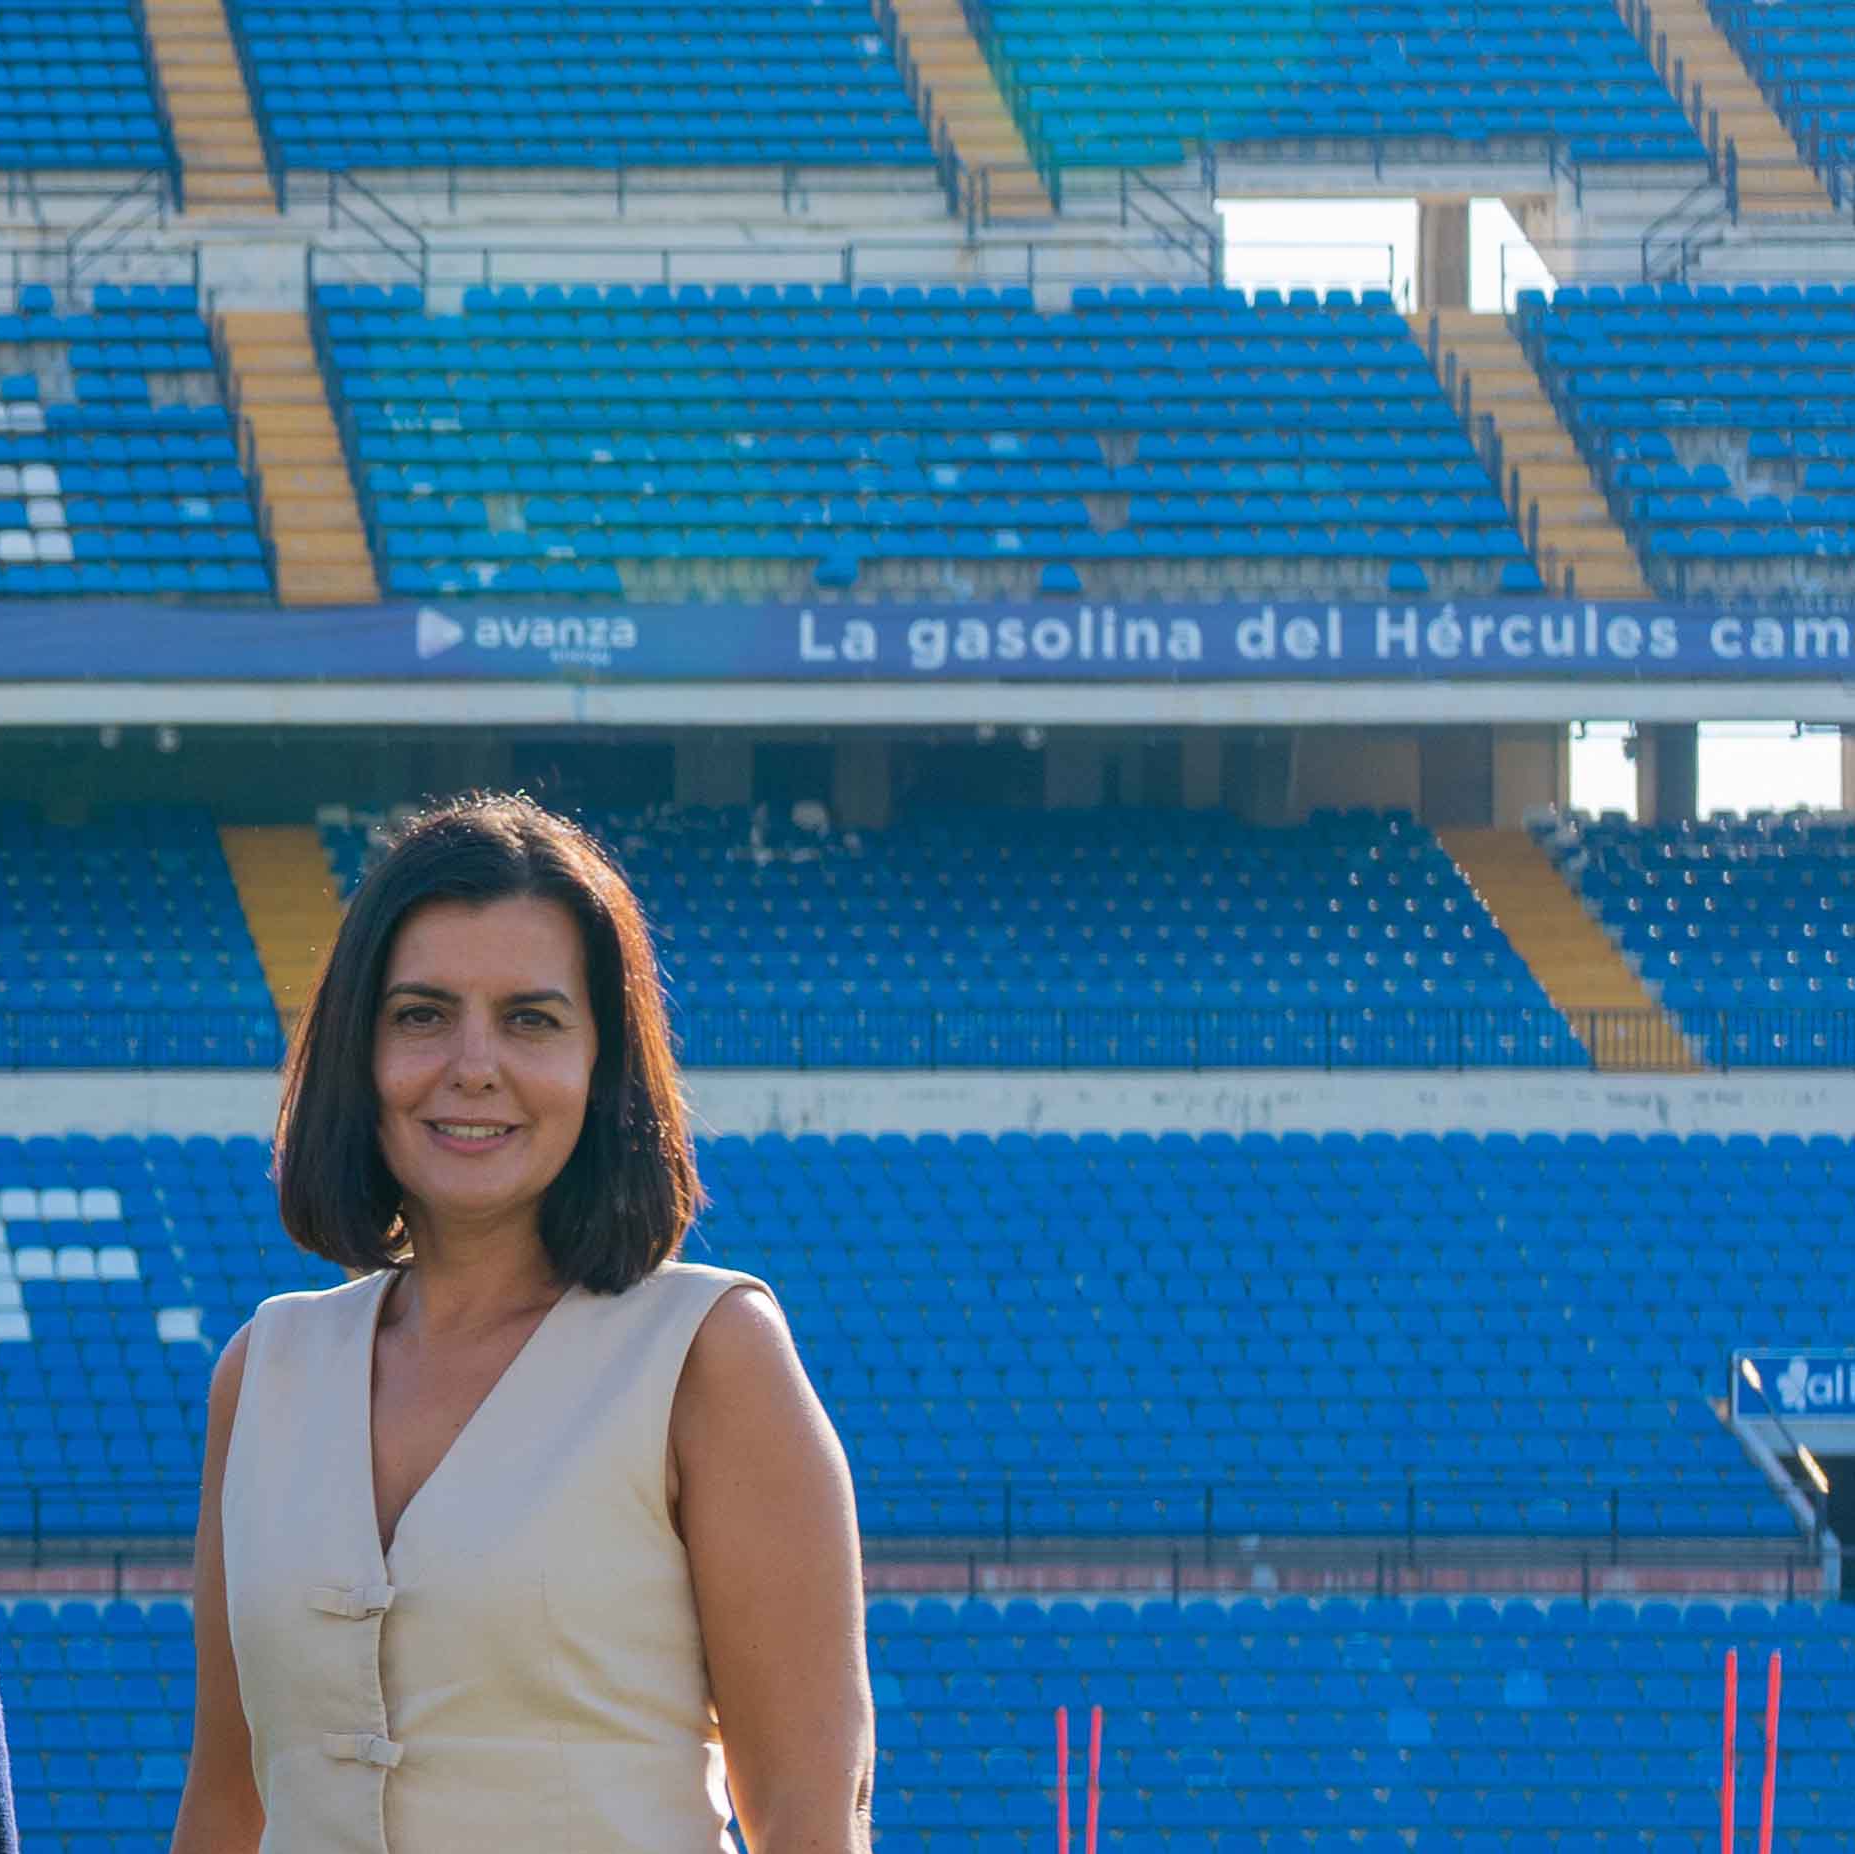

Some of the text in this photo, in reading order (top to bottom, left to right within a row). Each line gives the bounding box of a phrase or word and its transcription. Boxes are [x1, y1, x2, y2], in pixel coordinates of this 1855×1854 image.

[474, 616, 638, 649] avanza
[799, 602, 1850, 670] La gasolina del Hércules cam
